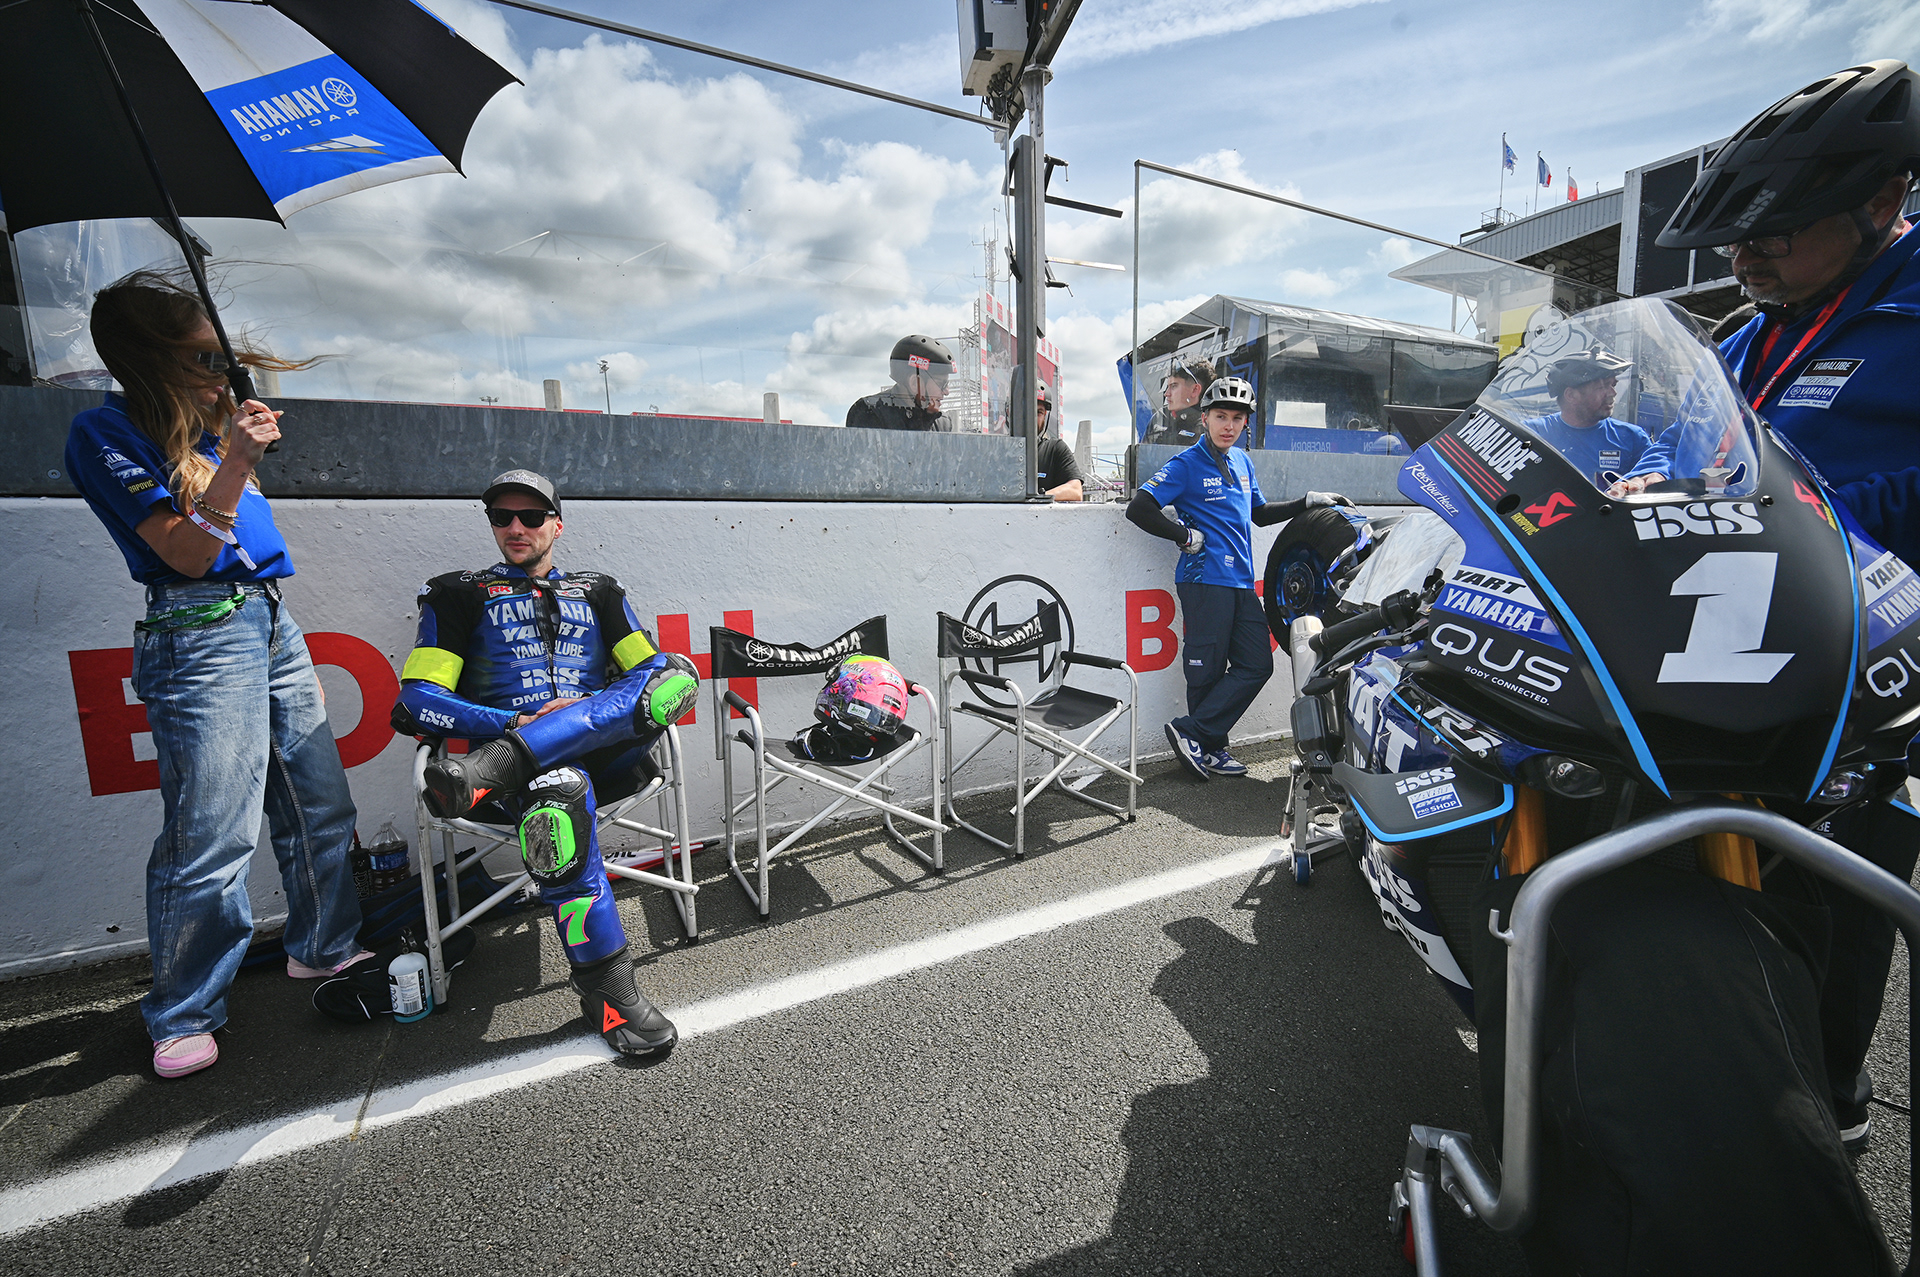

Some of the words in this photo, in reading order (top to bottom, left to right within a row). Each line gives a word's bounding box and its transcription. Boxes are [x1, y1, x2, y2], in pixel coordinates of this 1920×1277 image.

[1812, 361, 1853, 371] YAMALUBE
[1800, 386, 1834, 396] YAMAHA
[1452, 569, 1526, 594] YART
[1867, 556, 1905, 590] YART
[489, 586, 511, 594] RK
[1872, 578, 1920, 628] YAMAH
[487, 599, 595, 626] YAMAHA
[1443, 588, 1535, 632] YAMAHA
[1657, 551, 1796, 684] 1
[502, 621, 590, 643] YART
[774, 630, 862, 663] YAMAHA
[1430, 622, 1570, 693] QUS
[1866, 635, 1920, 698] QU
[512, 691, 551, 707] DMG
[1464, 665, 1490, 680] BODY
[1491, 676, 1550, 706] CONNECTED.
[544, 799, 569, 810] FACE
[1429, 800, 1457, 813] SHOP
[553, 857, 579, 878] POWER
[558, 895, 599, 947] 7
